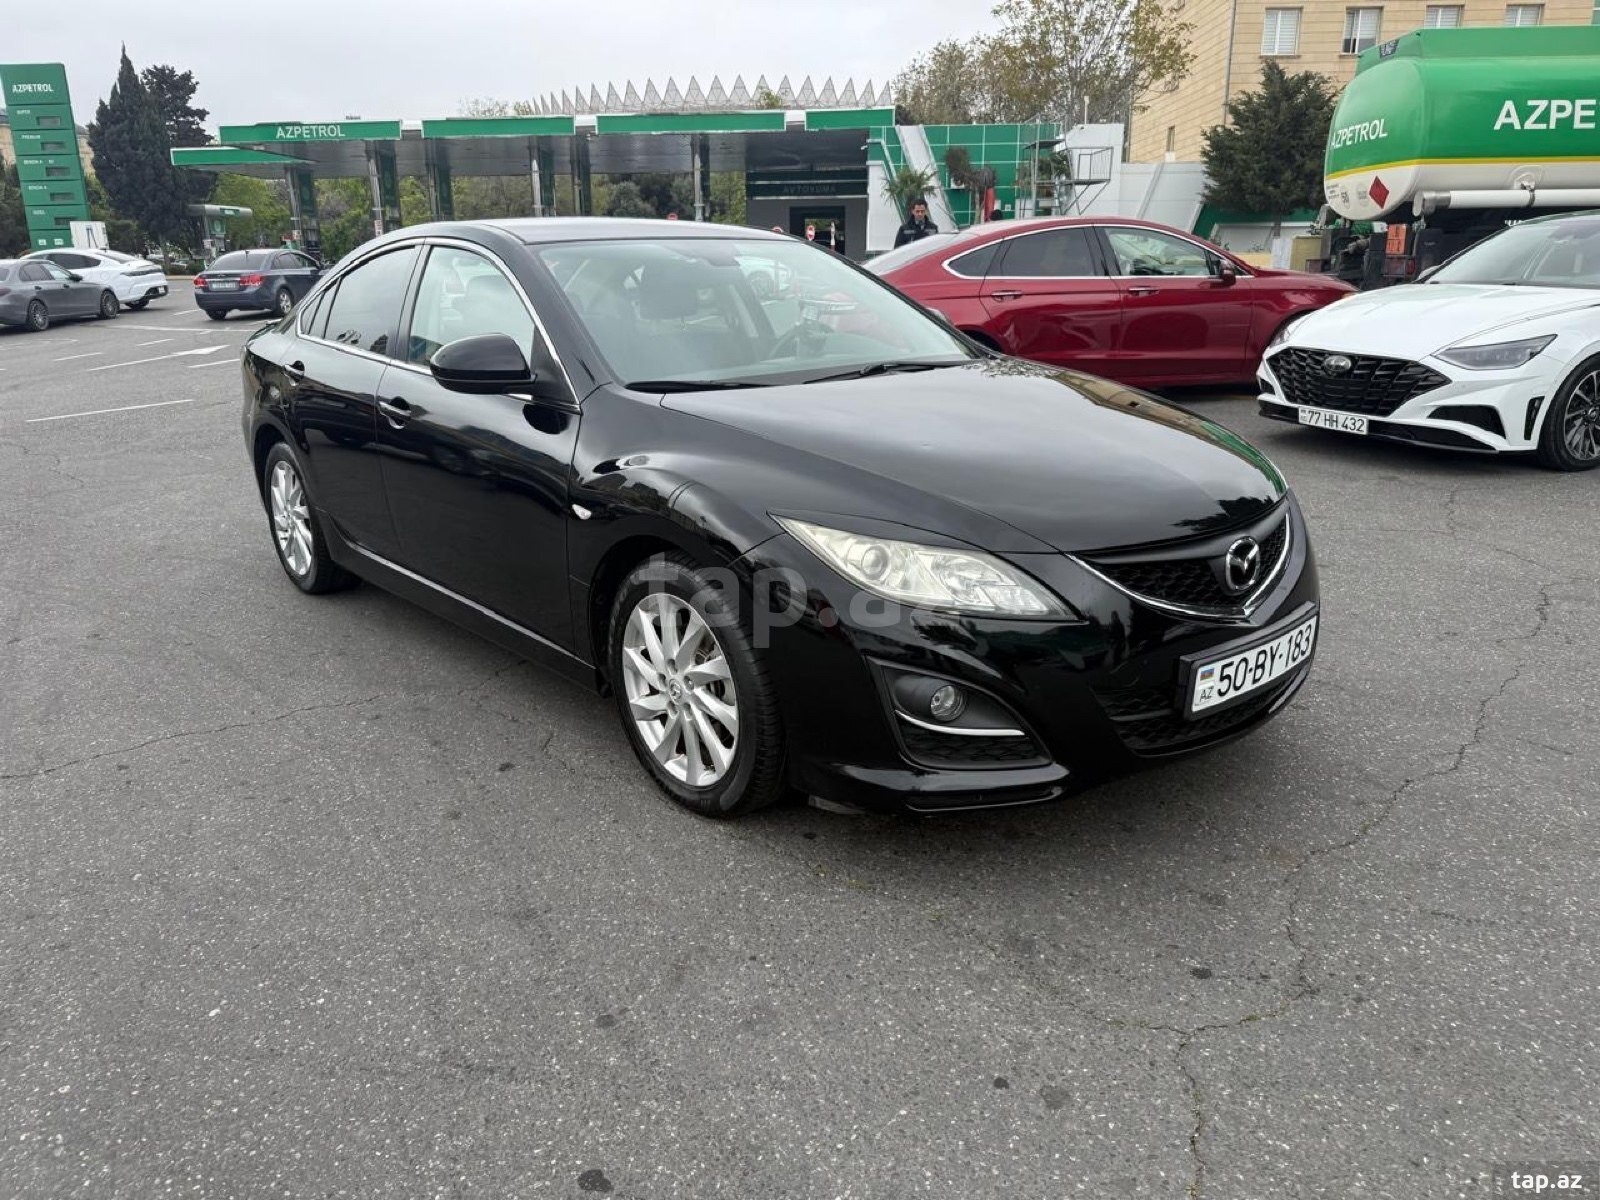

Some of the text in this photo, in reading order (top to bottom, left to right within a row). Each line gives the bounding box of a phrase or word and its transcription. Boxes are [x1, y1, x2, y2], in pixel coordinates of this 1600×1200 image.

[12, 83, 54, 93] AZPETROL
[275, 124, 346, 139] AZPETROL
[1330, 118, 1388, 150] AZPETROL
[1308, 410, 1321, 425] 77
[1324, 413, 1338, 428] HH
[1341, 416, 1365, 433] 432
[1200, 686, 1214, 701] AZ
